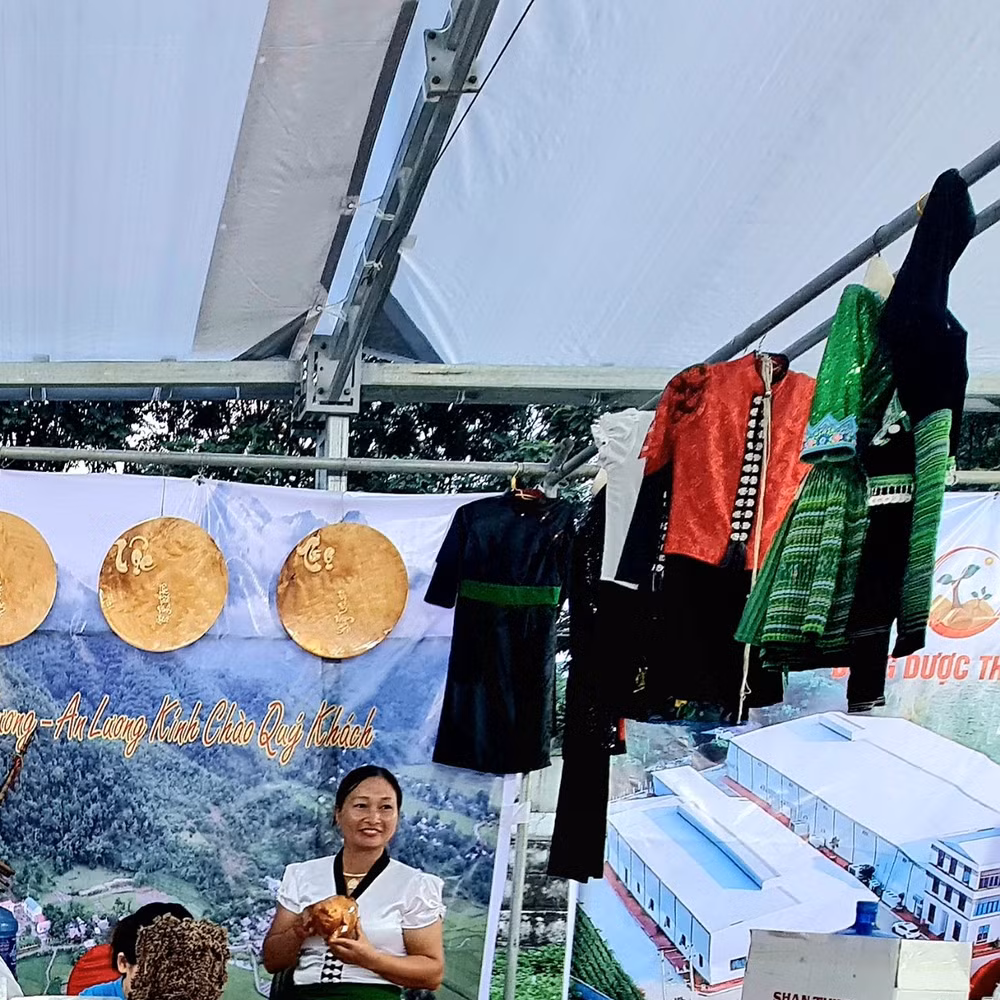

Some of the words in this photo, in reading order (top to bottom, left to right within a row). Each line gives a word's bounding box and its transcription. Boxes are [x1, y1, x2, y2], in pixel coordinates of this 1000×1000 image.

[904, 653, 970, 685] DƯỢC
[55, 690, 87, 741] An
[203, 698, 256, 747] Chào
[257, 700, 306, 766] Quý
[305, 700, 378, 749] Khách
